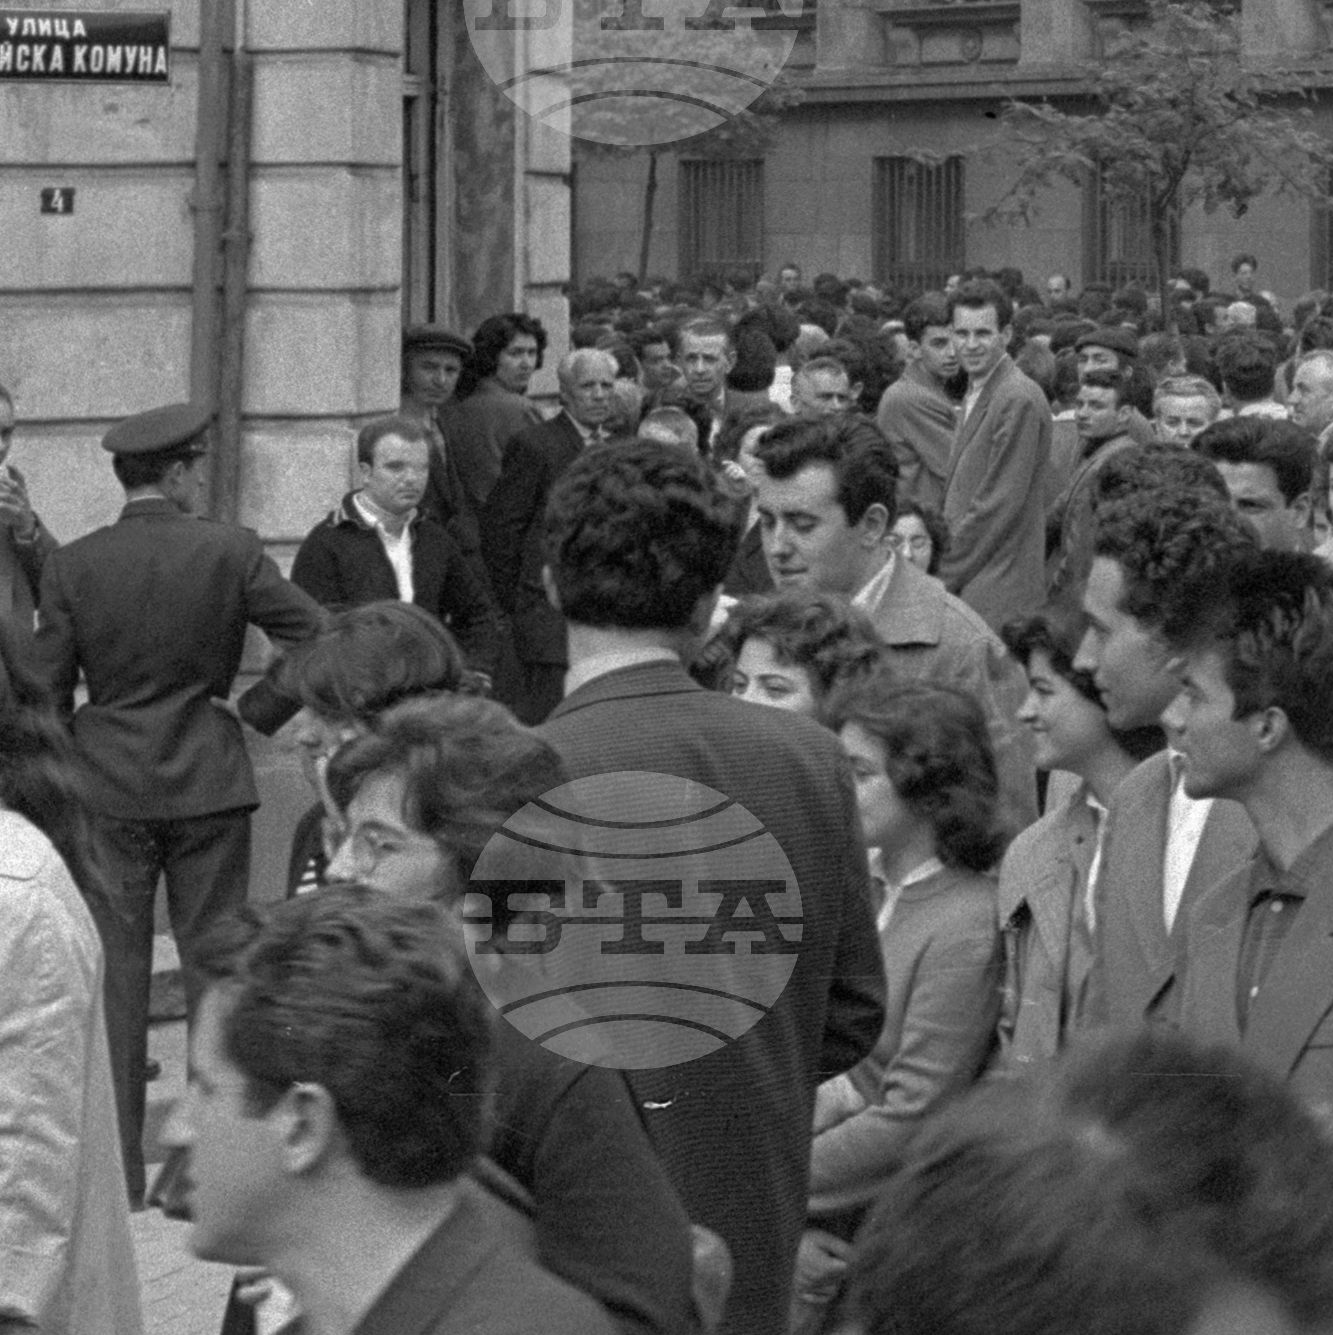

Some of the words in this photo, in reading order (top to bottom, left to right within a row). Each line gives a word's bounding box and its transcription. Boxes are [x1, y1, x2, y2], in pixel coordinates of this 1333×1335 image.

[6, 17, 87, 39] УЛИЦА
[73, 44, 168, 74] КОМУНА
[51, 188, 64, 213] 4
